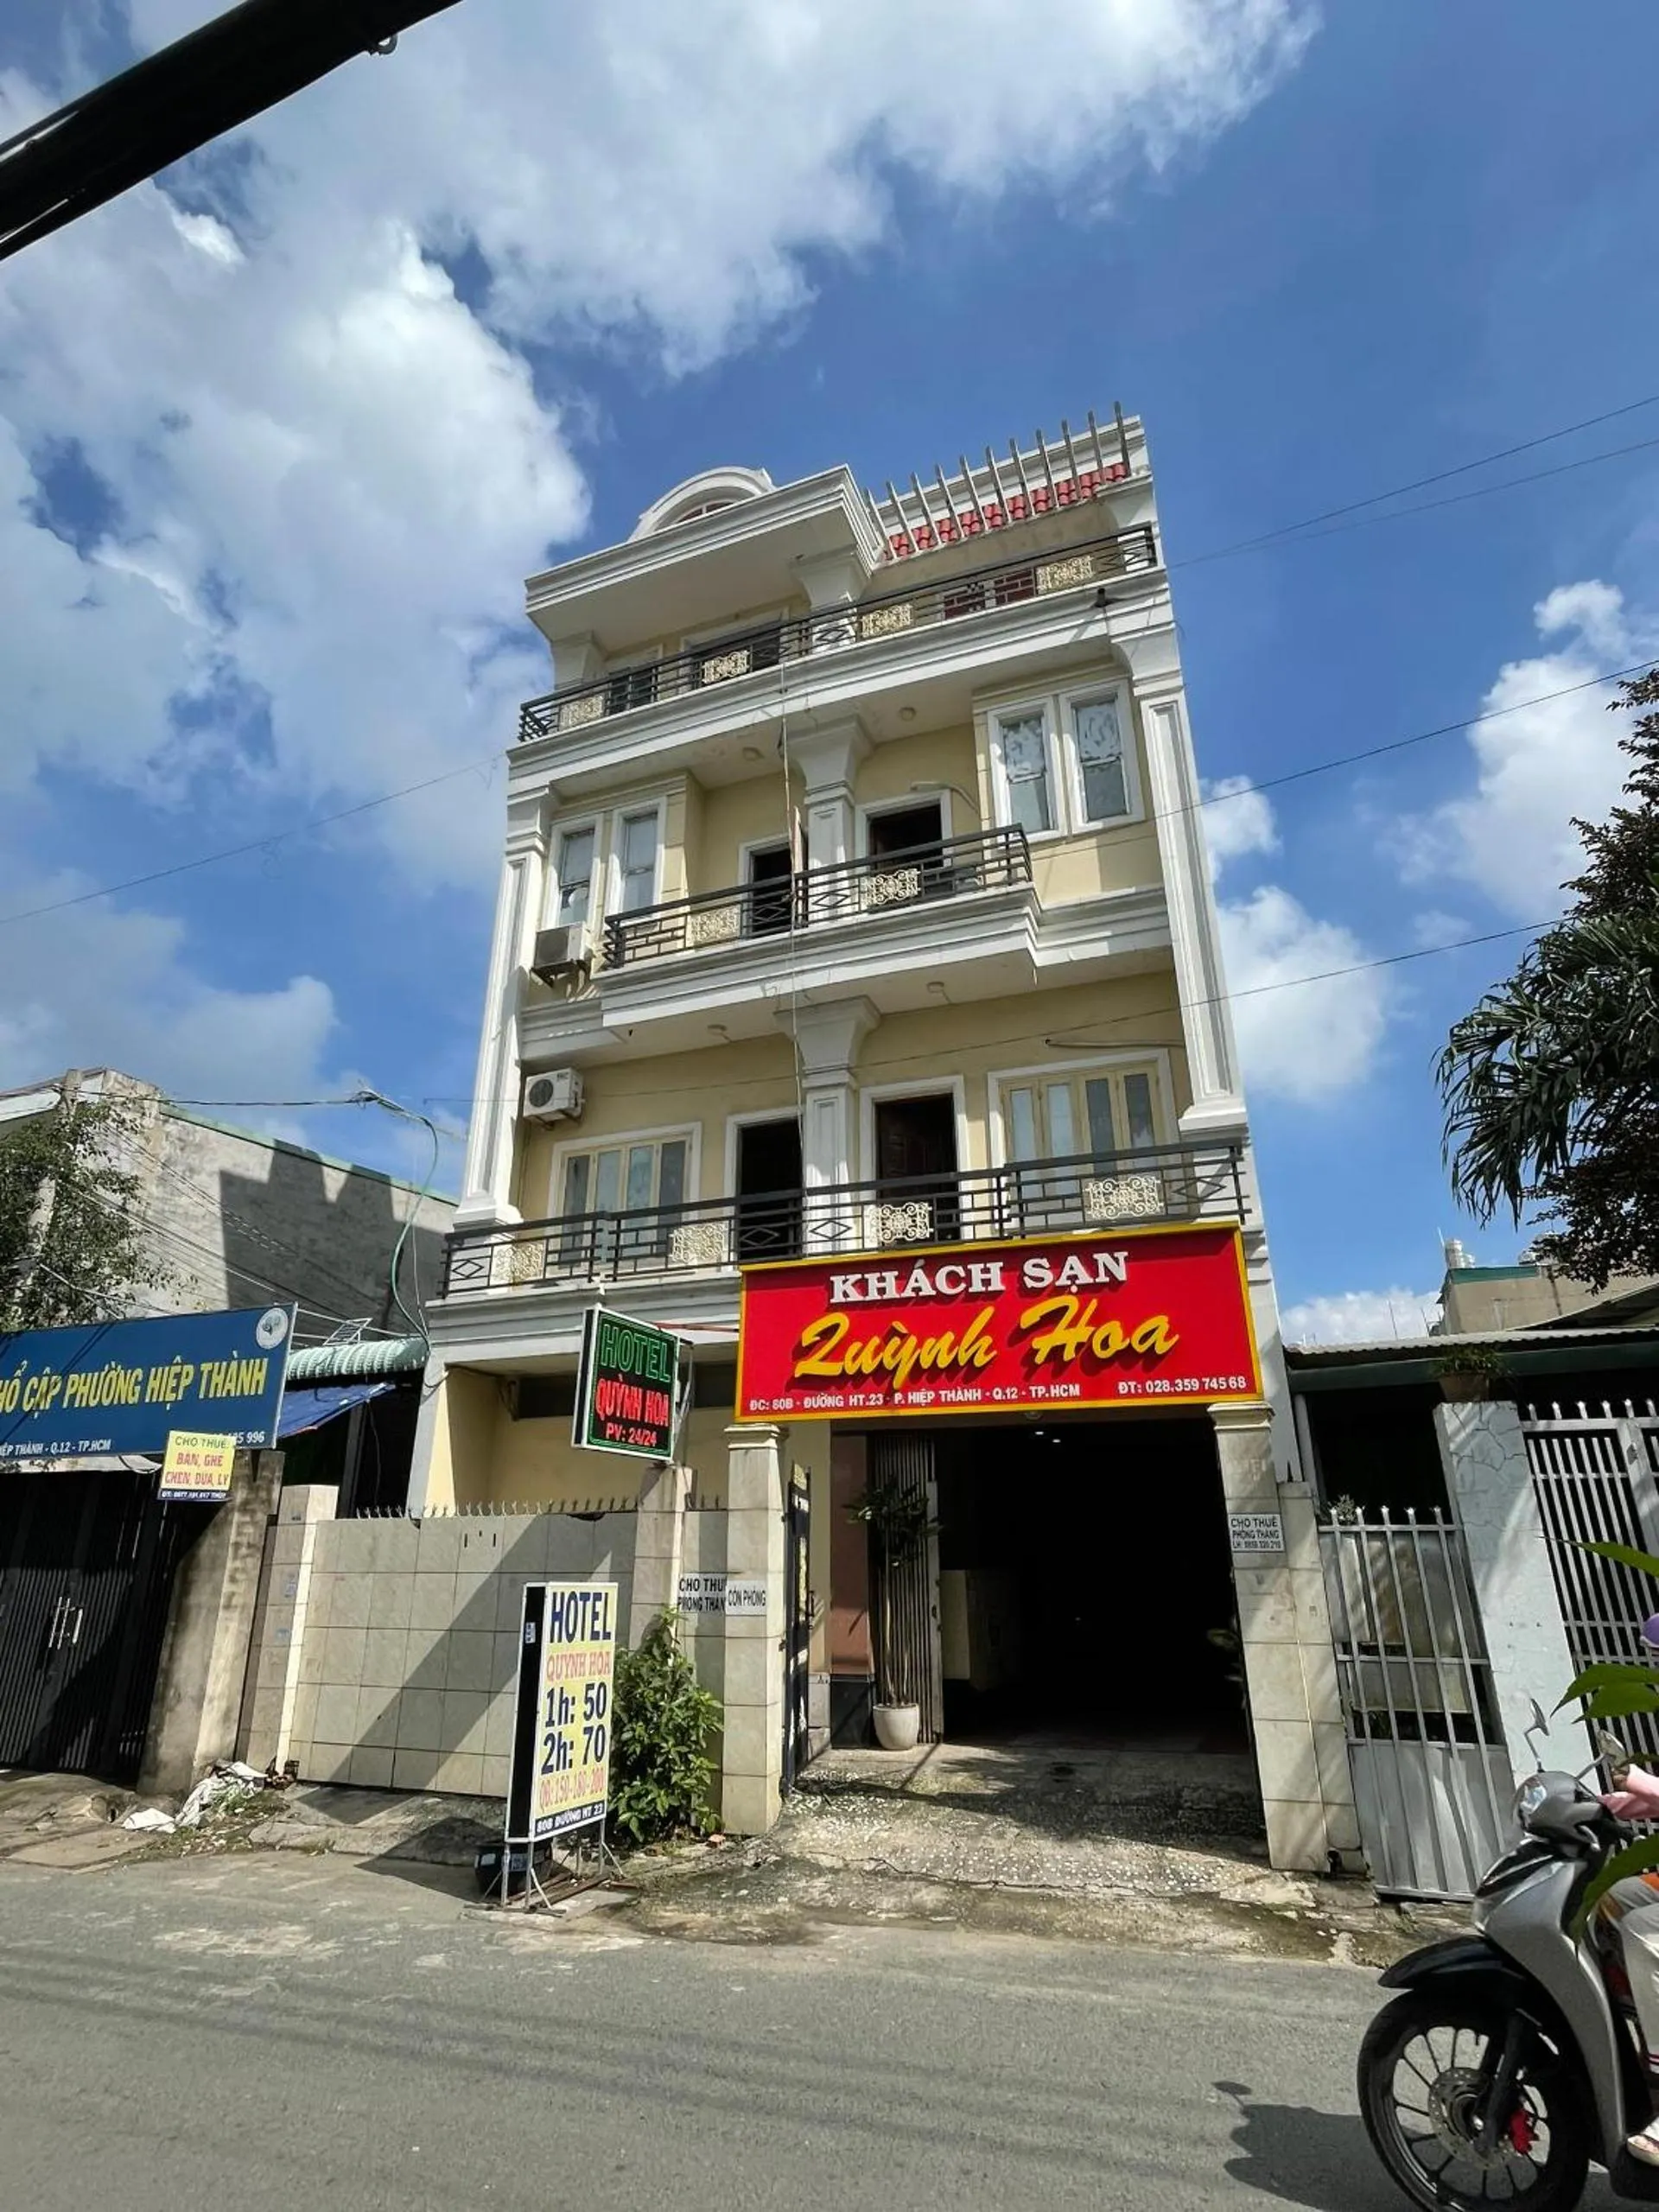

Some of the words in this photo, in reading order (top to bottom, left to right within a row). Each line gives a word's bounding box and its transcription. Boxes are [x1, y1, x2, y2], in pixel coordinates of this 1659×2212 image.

[830, 1259, 1006, 1304] KHÁCH
[1022, 1252, 1128, 1294] SẠN
[600, 1323, 671, 1383] HOTEL
[794, 1306, 997, 1389] Quỳnh
[1020, 1294, 1179, 1365] Hoa
[22, 1366, 62, 1420] CẬP
[62, 1361, 143, 1408] PHƯỜNG
[145, 1355, 194, 1411] HIỆP
[199, 1351, 269, 1400] THÀNH
[595, 1373, 643, 1421] QUỲNH
[645, 1389, 670, 1427] HOA
[804, 1392, 844, 1409] ĐƯỜNG
[849, 1393, 884, 1407] HT.23
[907, 1388, 936, 1407] HIỆP
[939, 1385, 982, 1402] THÀNH
[992, 1387, 1019, 1401] Q.12
[1029, 1383, 1080, 1398] TP.HCM
[1117, 1380, 1142, 1395] ĐT:
[50, 1441, 71, 1454] Q.12
[79, 1438, 112, 1452] TP.HCM
[606, 1422, 626, 1441] PV:
[628, 1427, 657, 1447] 24/24
[1231, 1518, 1251, 1528] CHO
[679, 1578, 700, 1592] CHO
[703, 1578, 727, 1592] THU
[550, 1591, 612, 1643] HOTEL
[545, 1686, 576, 1728] 1h:
[582, 1681, 607, 1720] 50
[540, 1731, 574, 1776] 2h:
[582, 1724, 607, 1765] 70
